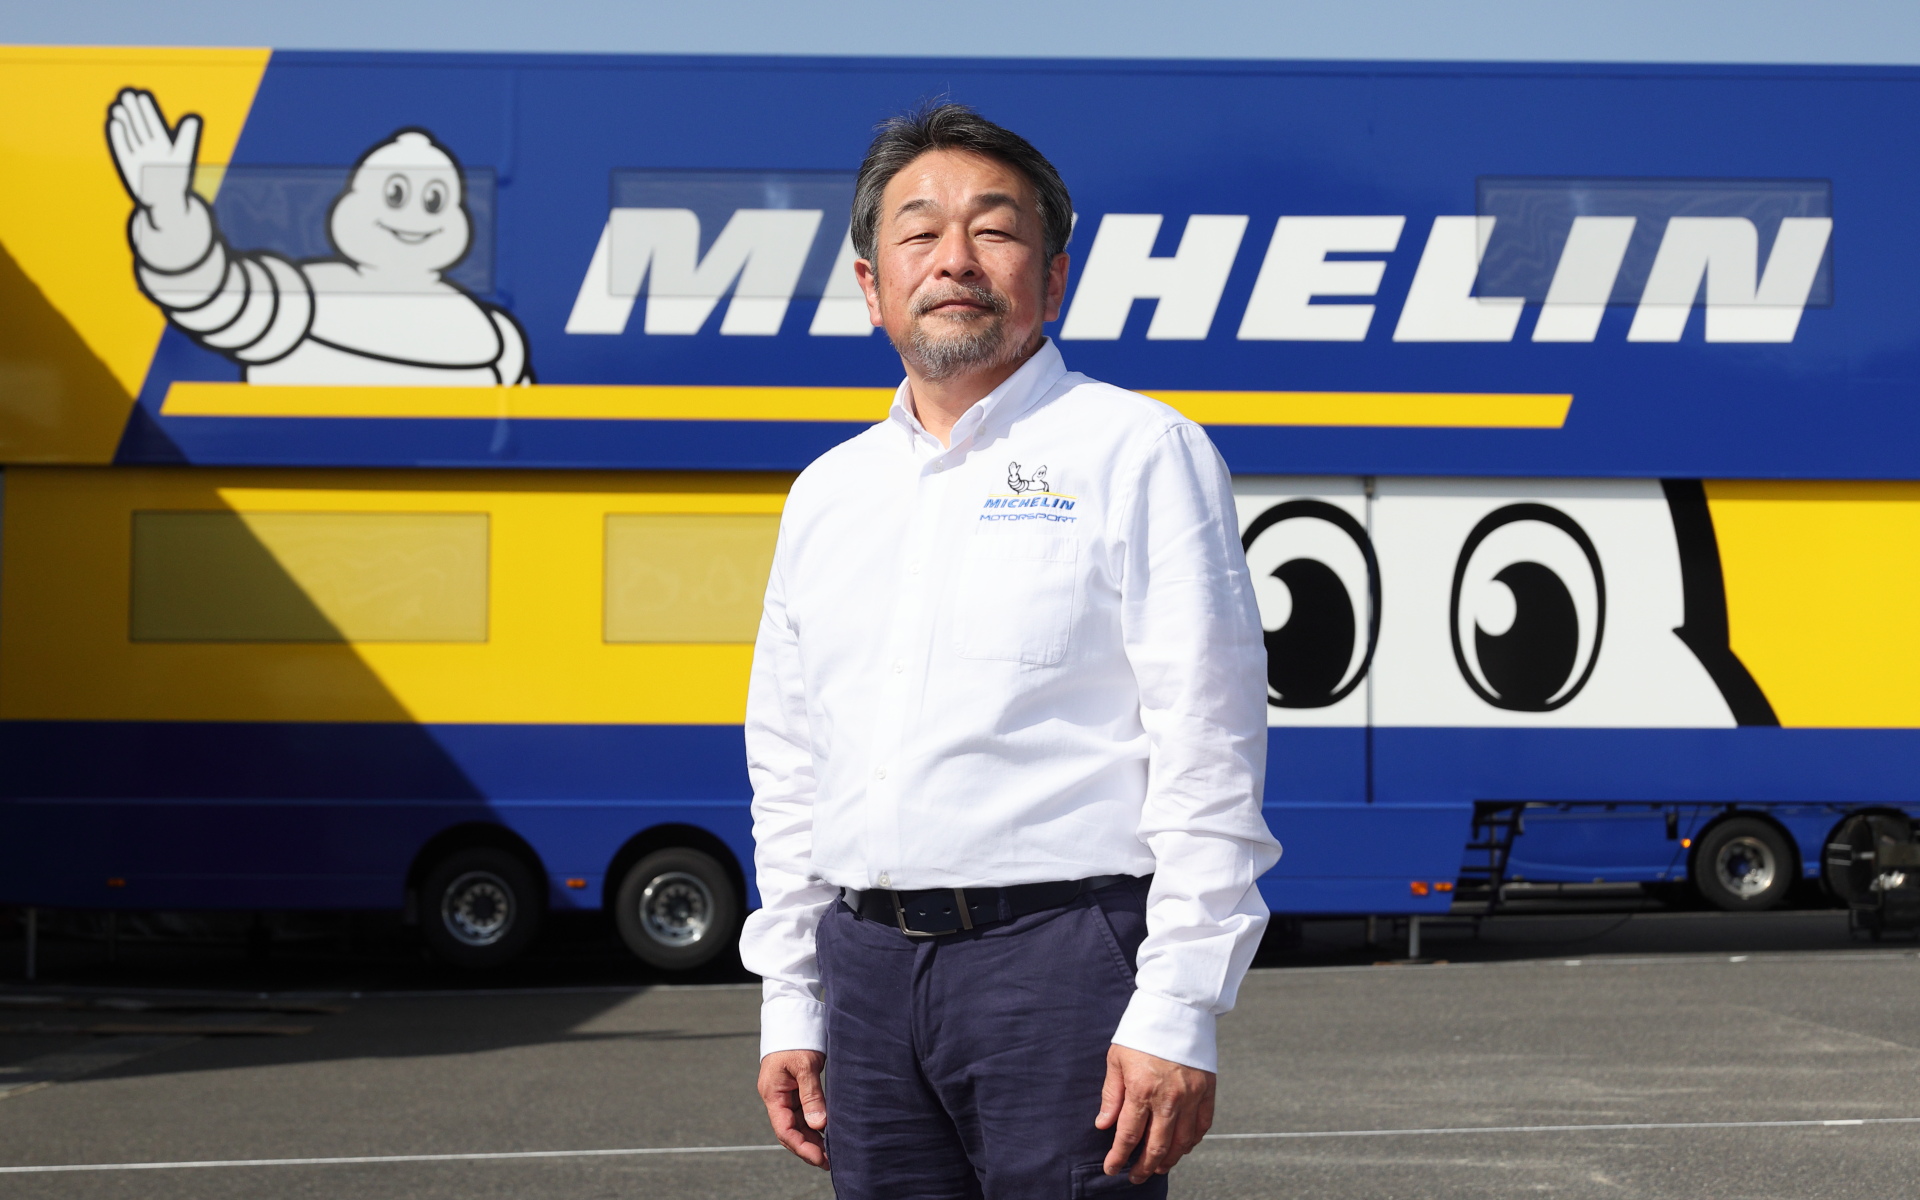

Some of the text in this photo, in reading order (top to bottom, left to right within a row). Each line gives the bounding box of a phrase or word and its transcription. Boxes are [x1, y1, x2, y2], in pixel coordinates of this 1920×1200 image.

[565, 207, 1833, 343] MHELIN
[983, 497, 1076, 510] MICHELIN
[979, 513, 1077, 523] MOTORSPORT
